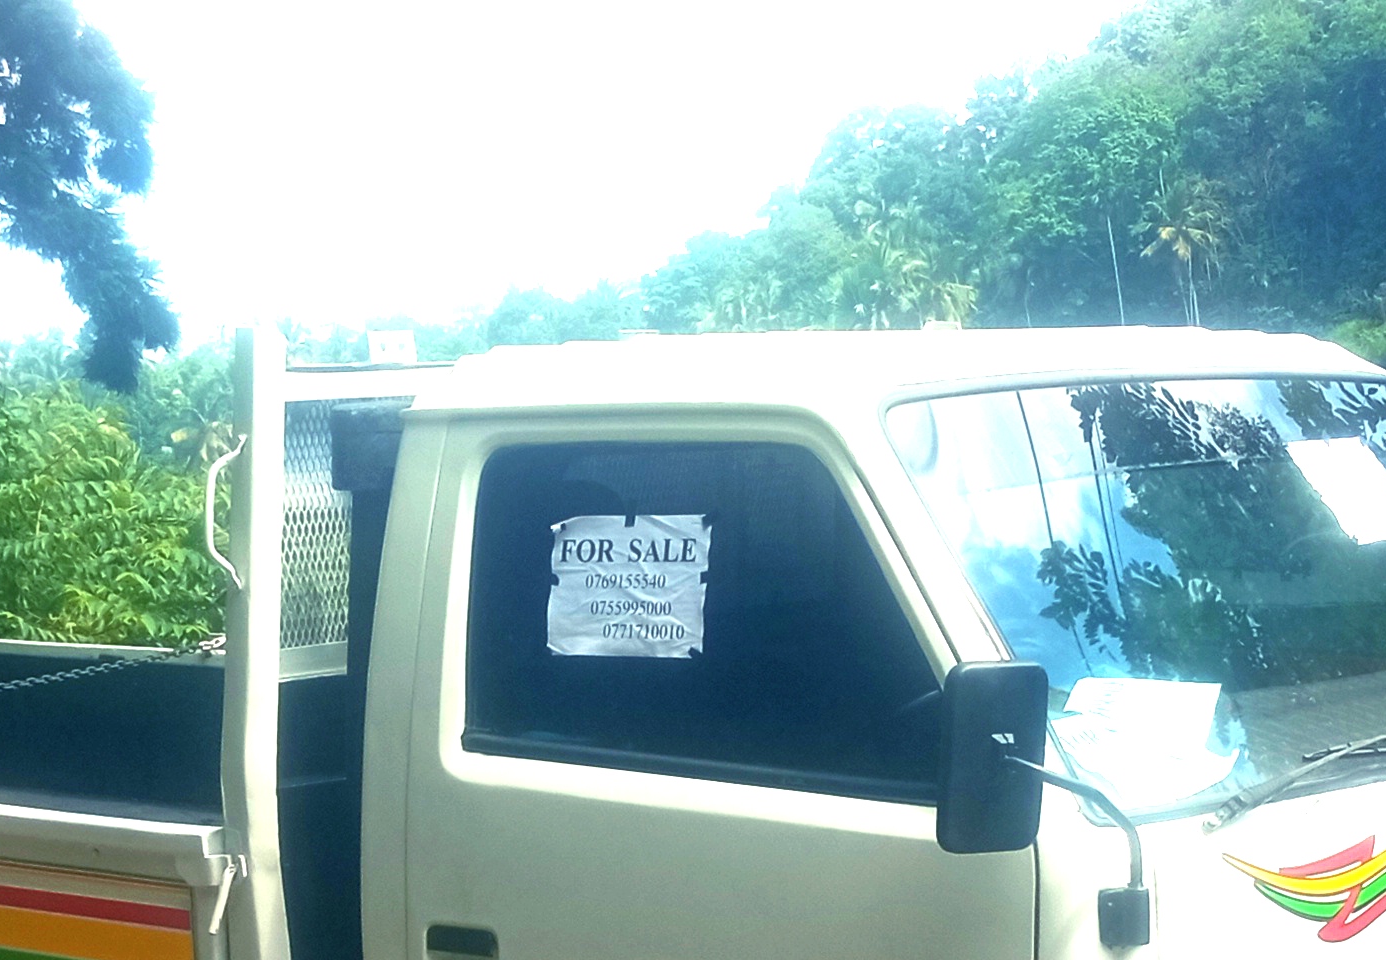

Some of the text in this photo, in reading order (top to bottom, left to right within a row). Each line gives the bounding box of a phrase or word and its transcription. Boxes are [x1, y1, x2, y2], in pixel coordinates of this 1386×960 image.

[559, 538, 697, 563] FOR SALE
[585, 574, 667, 589] 0769155540
[590, 601, 672, 616] 0755995000
[602, 623, 685, 640] 0771710010
